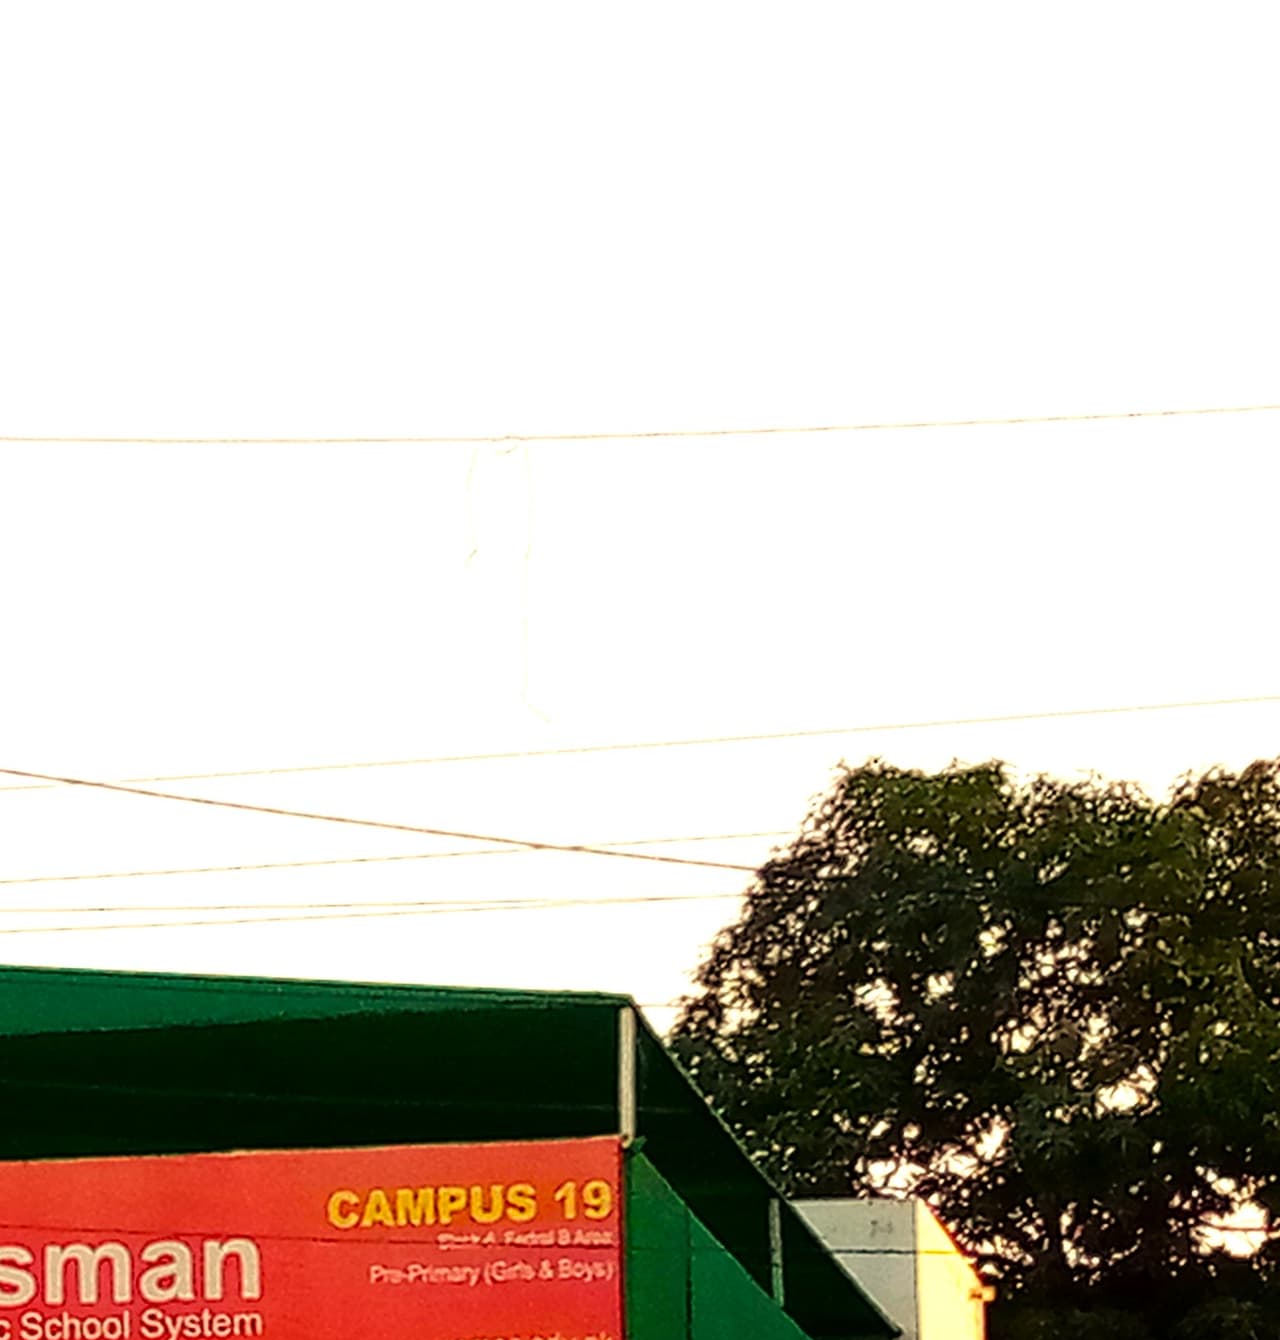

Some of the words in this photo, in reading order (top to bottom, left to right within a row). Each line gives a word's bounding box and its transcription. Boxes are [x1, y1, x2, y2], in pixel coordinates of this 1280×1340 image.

[327, 1183, 537, 1229] CAMPUS
[554, 1179, 613, 1220] 19
[369, 1263, 480, 1287] Pre-Primary
[538, 1258, 555, 1281] &
[557, 1257, 615, 1283] Boys)
